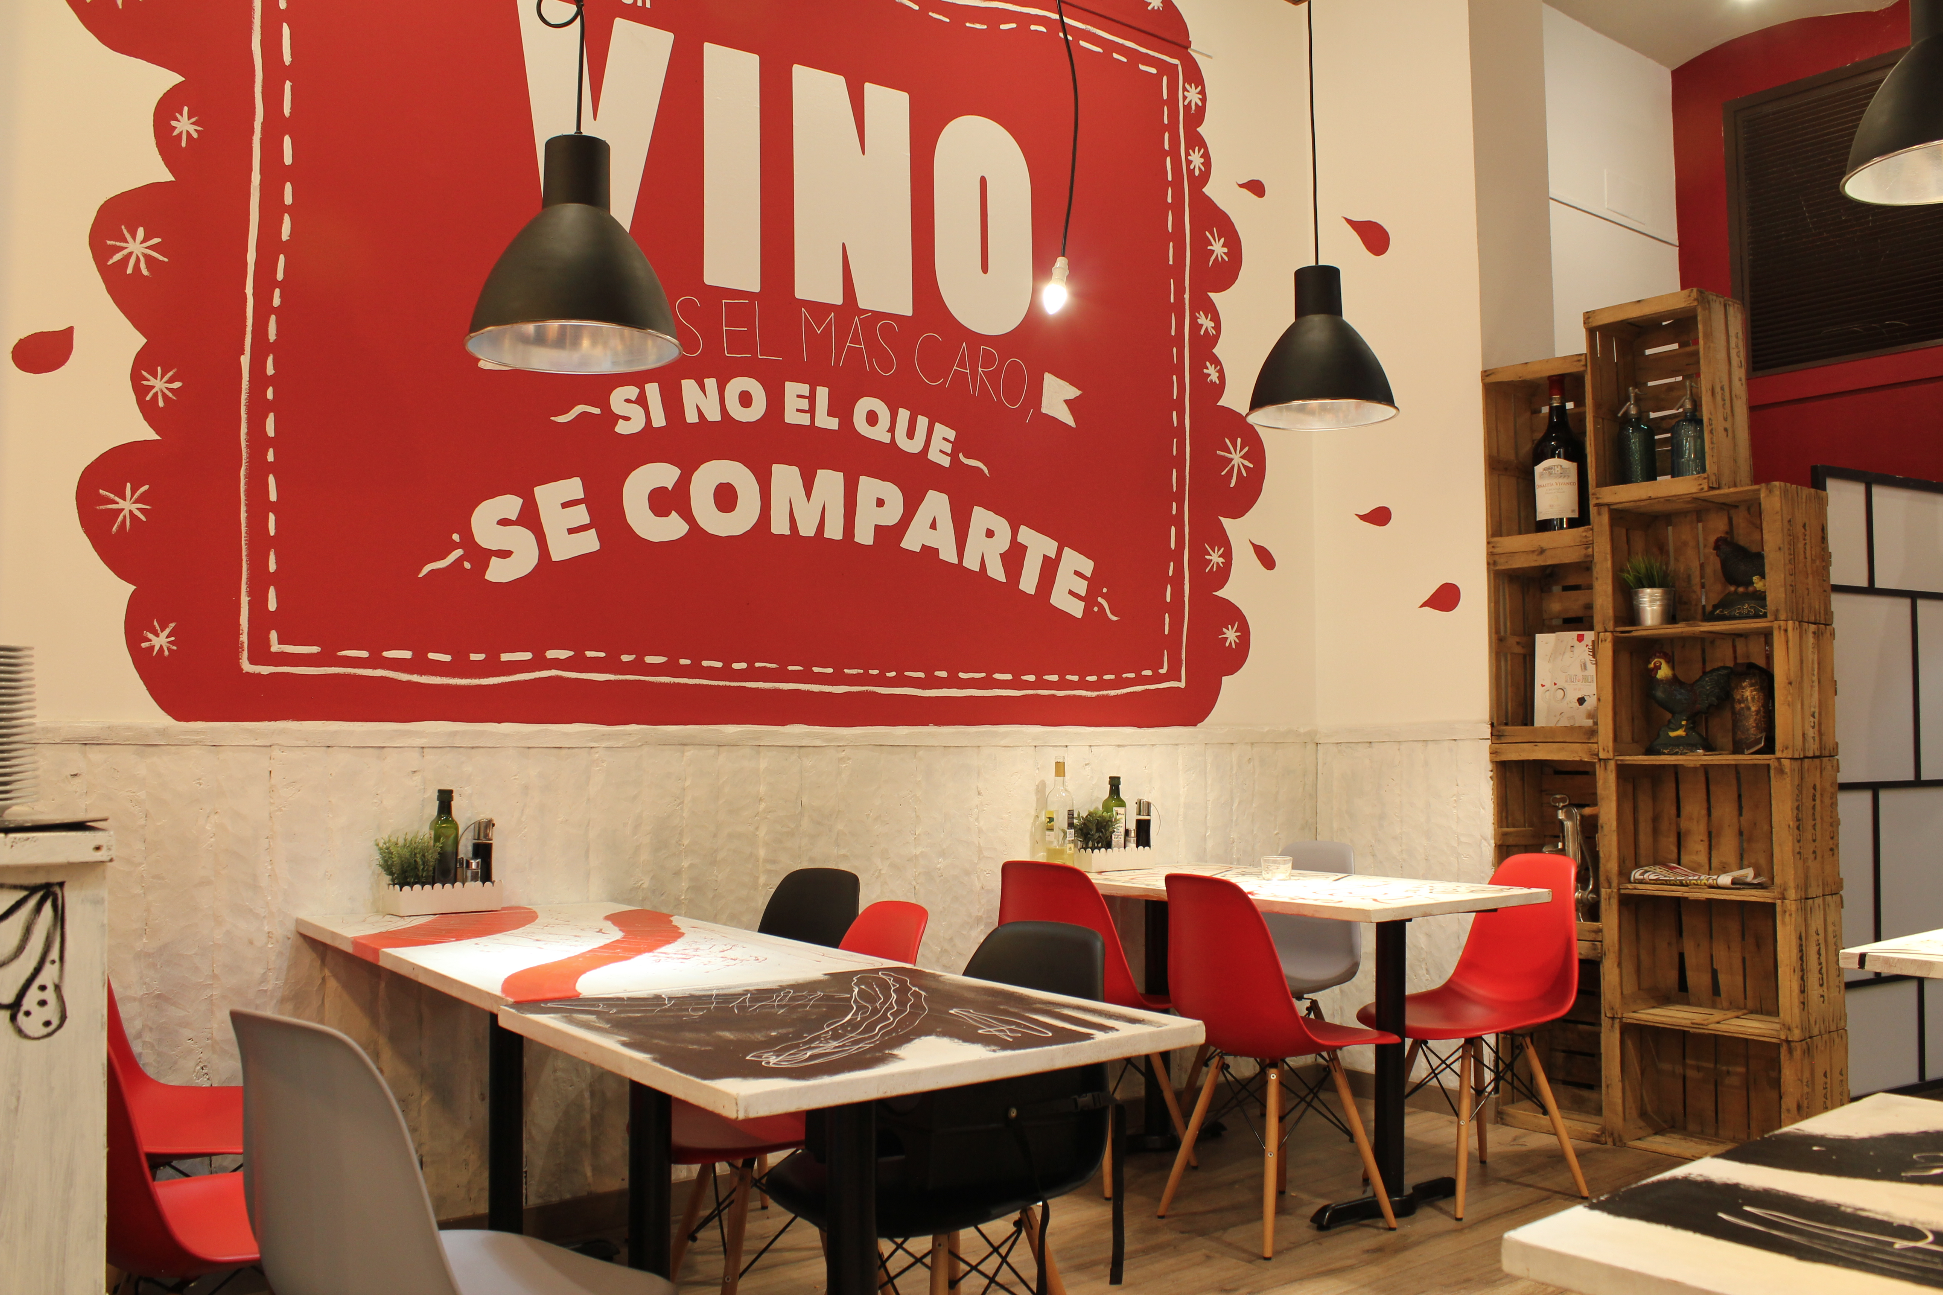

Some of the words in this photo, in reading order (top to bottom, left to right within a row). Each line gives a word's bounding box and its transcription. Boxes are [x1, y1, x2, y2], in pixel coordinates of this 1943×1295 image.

[516, 0, 1032, 336] VINO
[722, 300, 783, 361] EL
[801, 310, 898, 377] MÁS
[609, 382, 667, 436] SI
[681, 376, 768, 423] NO
[784, 381, 840, 431] EL
[852, 396, 957, 468] QUE
[470, 476, 601, 584] SE
[622, 459, 1095, 619] COMPARTE
